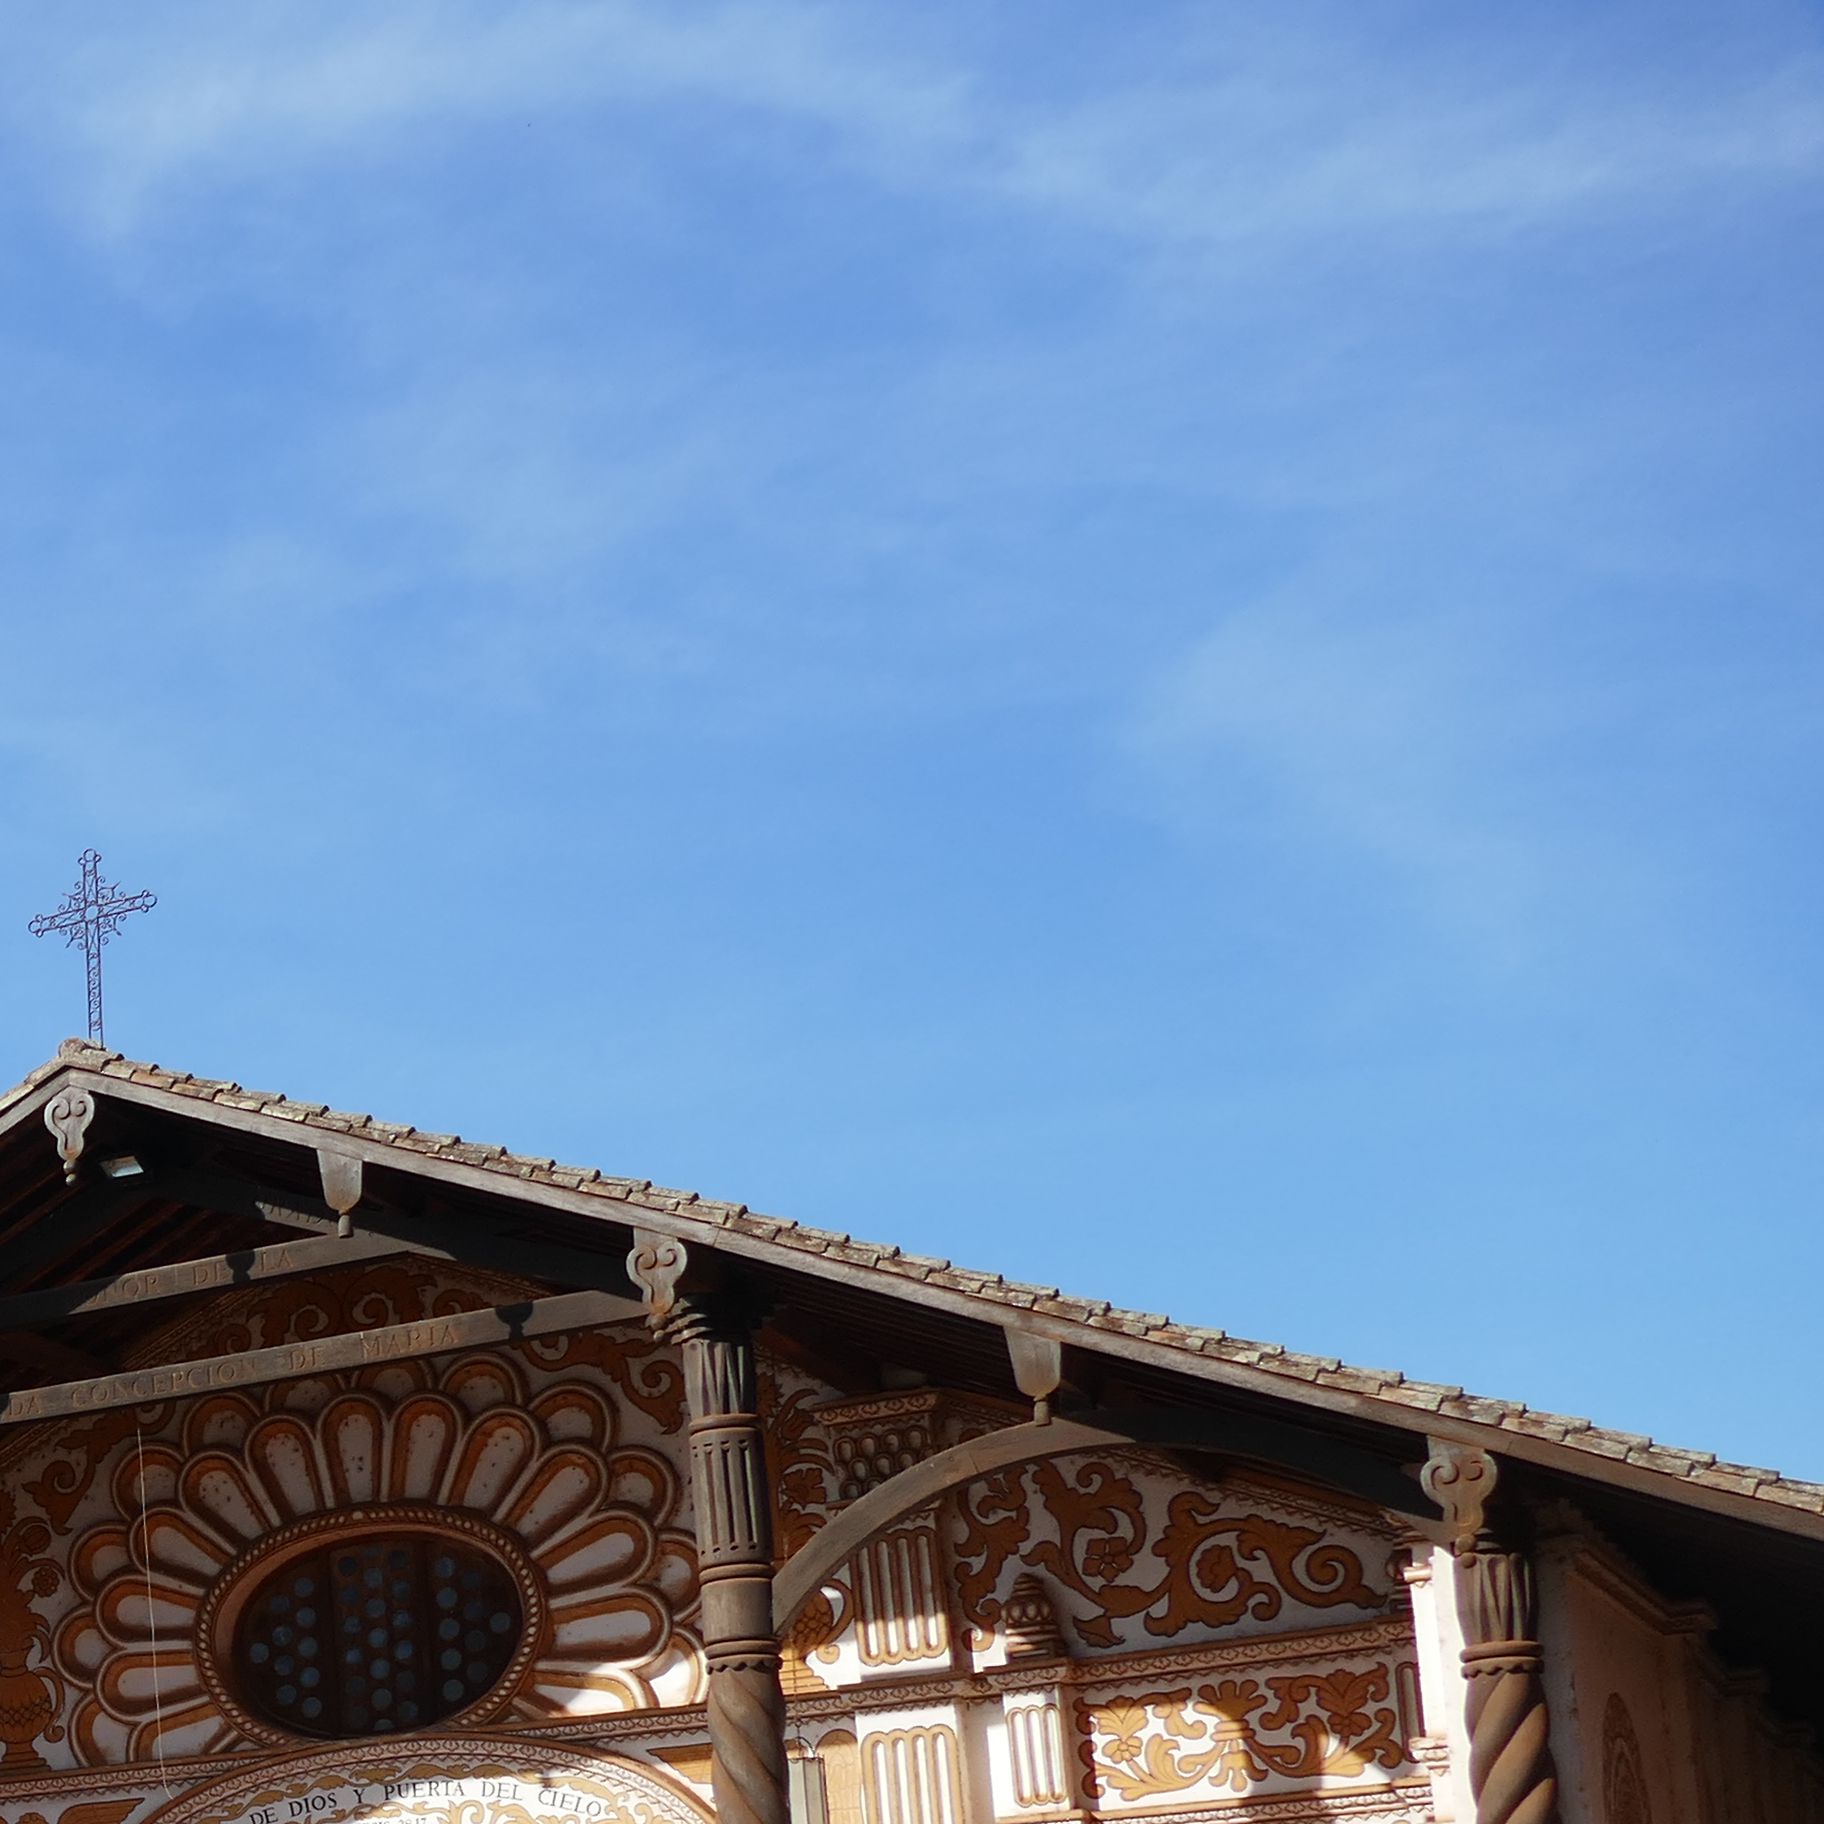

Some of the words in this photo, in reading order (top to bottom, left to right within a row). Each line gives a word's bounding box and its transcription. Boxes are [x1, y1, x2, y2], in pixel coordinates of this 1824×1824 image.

[259, 1250, 295, 1272] LA
[70, 1358, 256, 1409] CONCEPCION
[288, 1346, 325, 1371] DE
[360, 1324, 460, 1359] MARIA
[289, 1792, 337, 1818] DIOS
[353, 1788, 367, 1804] Y
[383, 1780, 465, 1801] PUERTA
[481, 1781, 523, 1801] DEL
[537, 1788, 602, 1817] CIELO
